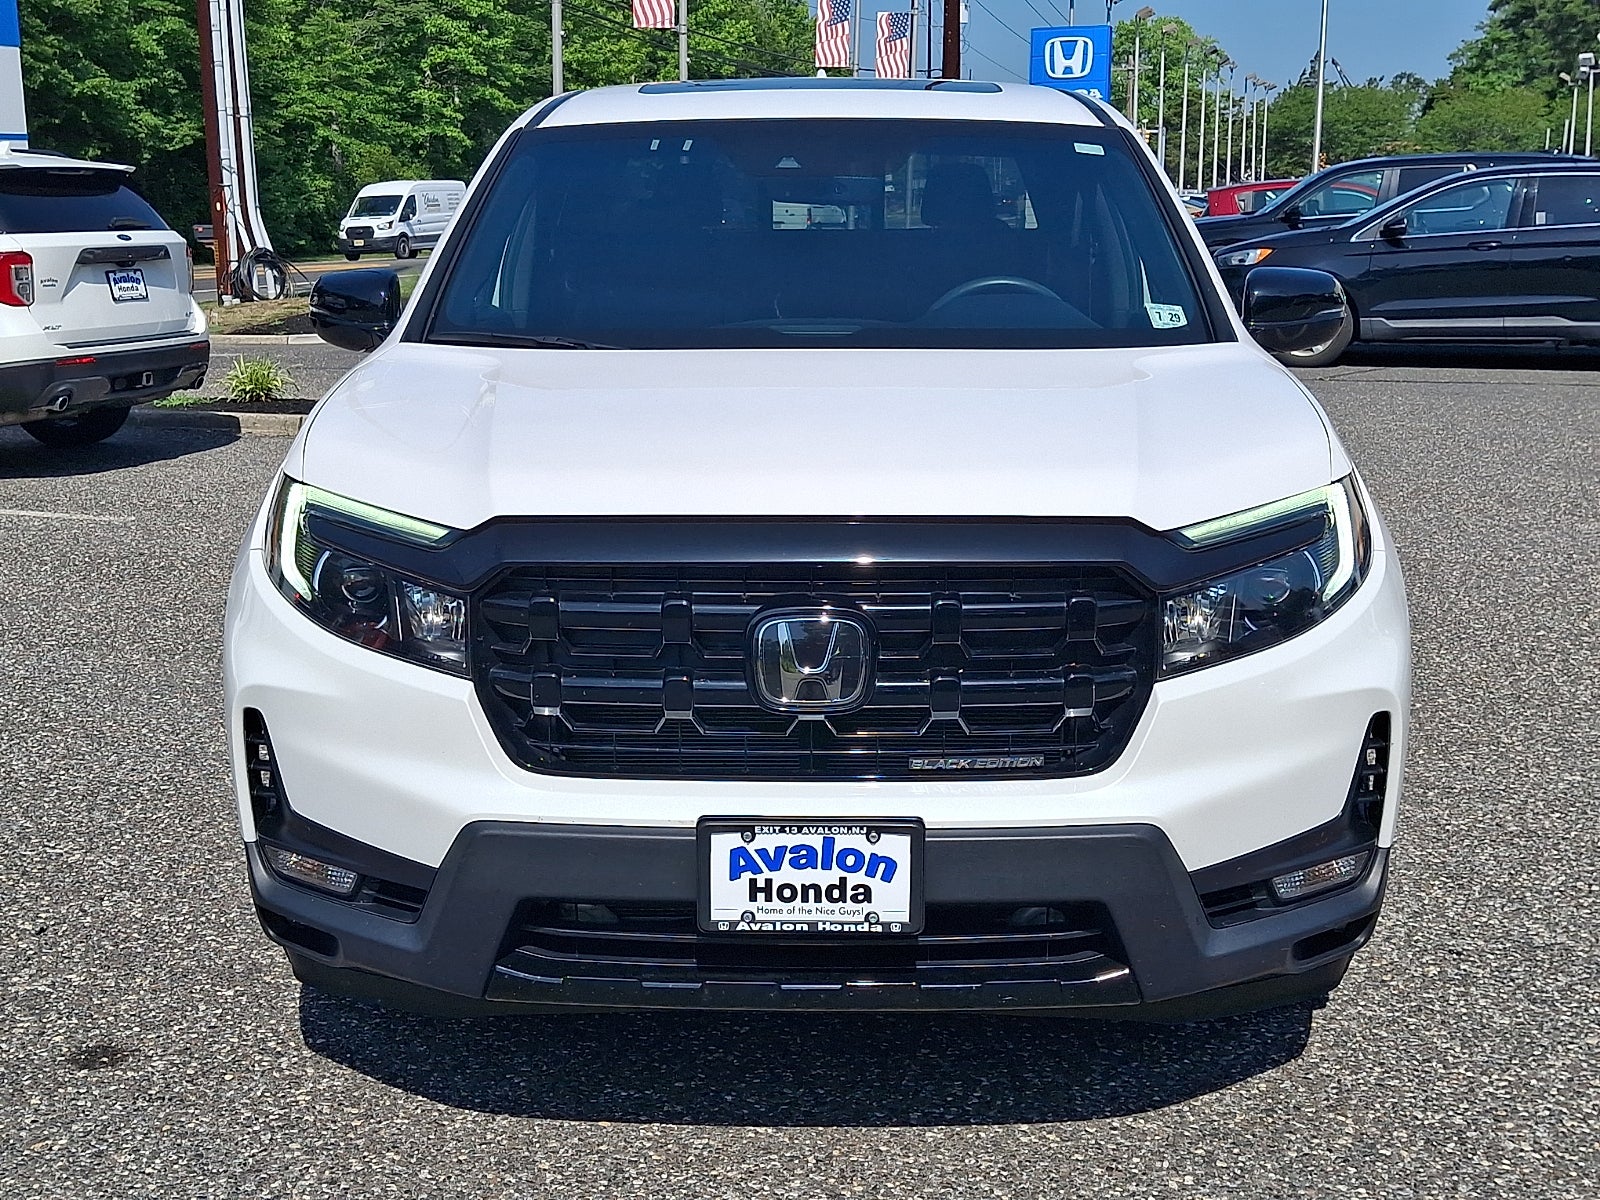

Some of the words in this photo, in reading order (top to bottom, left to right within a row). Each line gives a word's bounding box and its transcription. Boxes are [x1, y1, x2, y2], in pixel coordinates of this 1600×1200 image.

[112, 272, 141, 287] Avalon
[118, 284, 139, 292] Honda
[1155, 311, 1162, 322] 7
[1168, 312, 1181, 323] 29
[911, 759, 972, 769] BLACK
[975, 757, 1044, 768] EDITION
[754, 826, 781, 834] EXIT
[784, 826, 798, 834] 13
[729, 836, 898, 883] Avalon
[748, 876, 872, 904] Honda
[756, 906, 784, 915] Home
[786, 906, 796, 915] of
[798, 906, 813, 915] the
[815, 907, 836, 916] Nice
[838, 907, 864, 917] Guys!
[735, 921, 809, 931] Avalon
[818, 921, 883, 932] Honda
